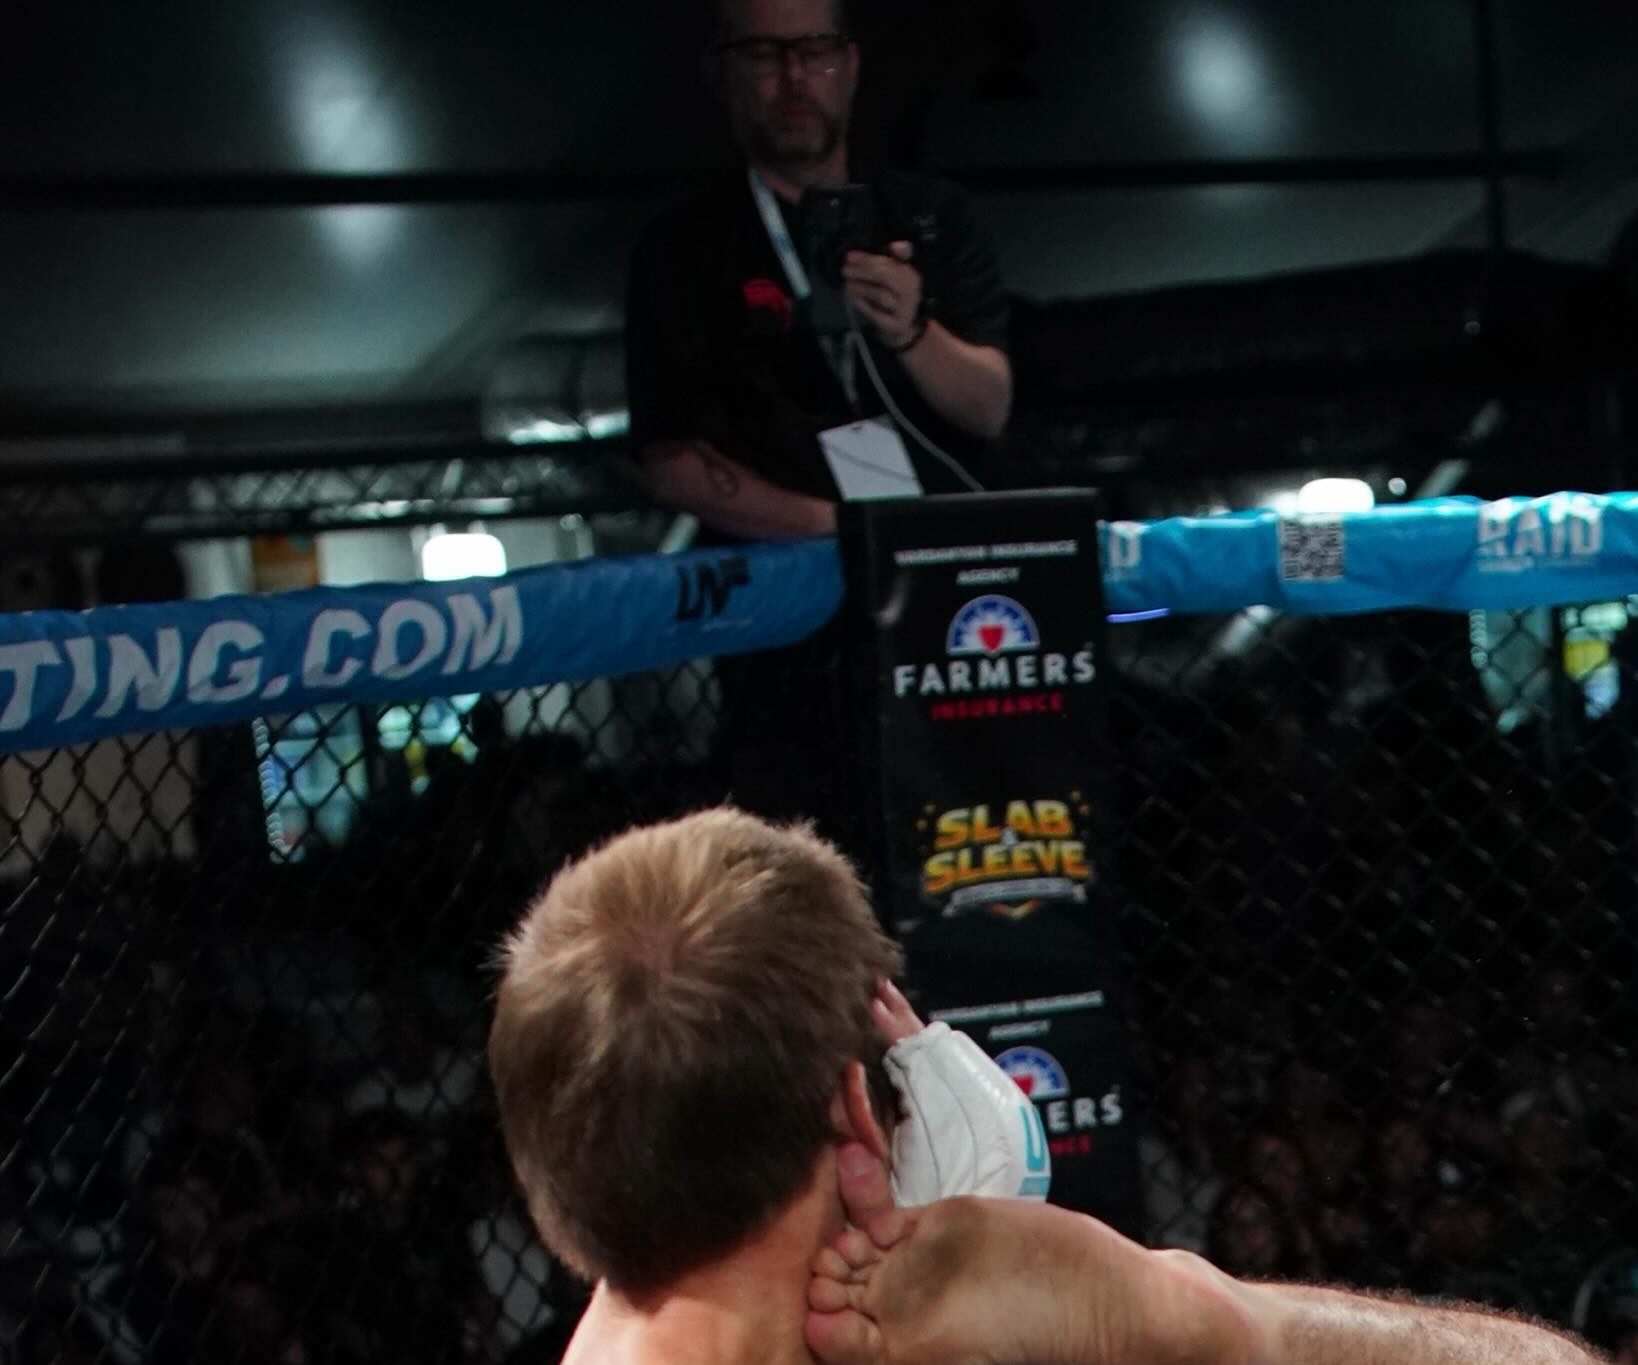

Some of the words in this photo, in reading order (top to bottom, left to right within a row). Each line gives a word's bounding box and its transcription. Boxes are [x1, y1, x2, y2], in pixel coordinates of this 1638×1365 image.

[1478, 500, 1602, 558] RAID
[893, 650, 1096, 698] FARMERS
[931, 693, 1064, 720] INSURANCE
[935, 799, 1074, 850] SLAB
[923, 840, 1092, 896] SLEEVE
